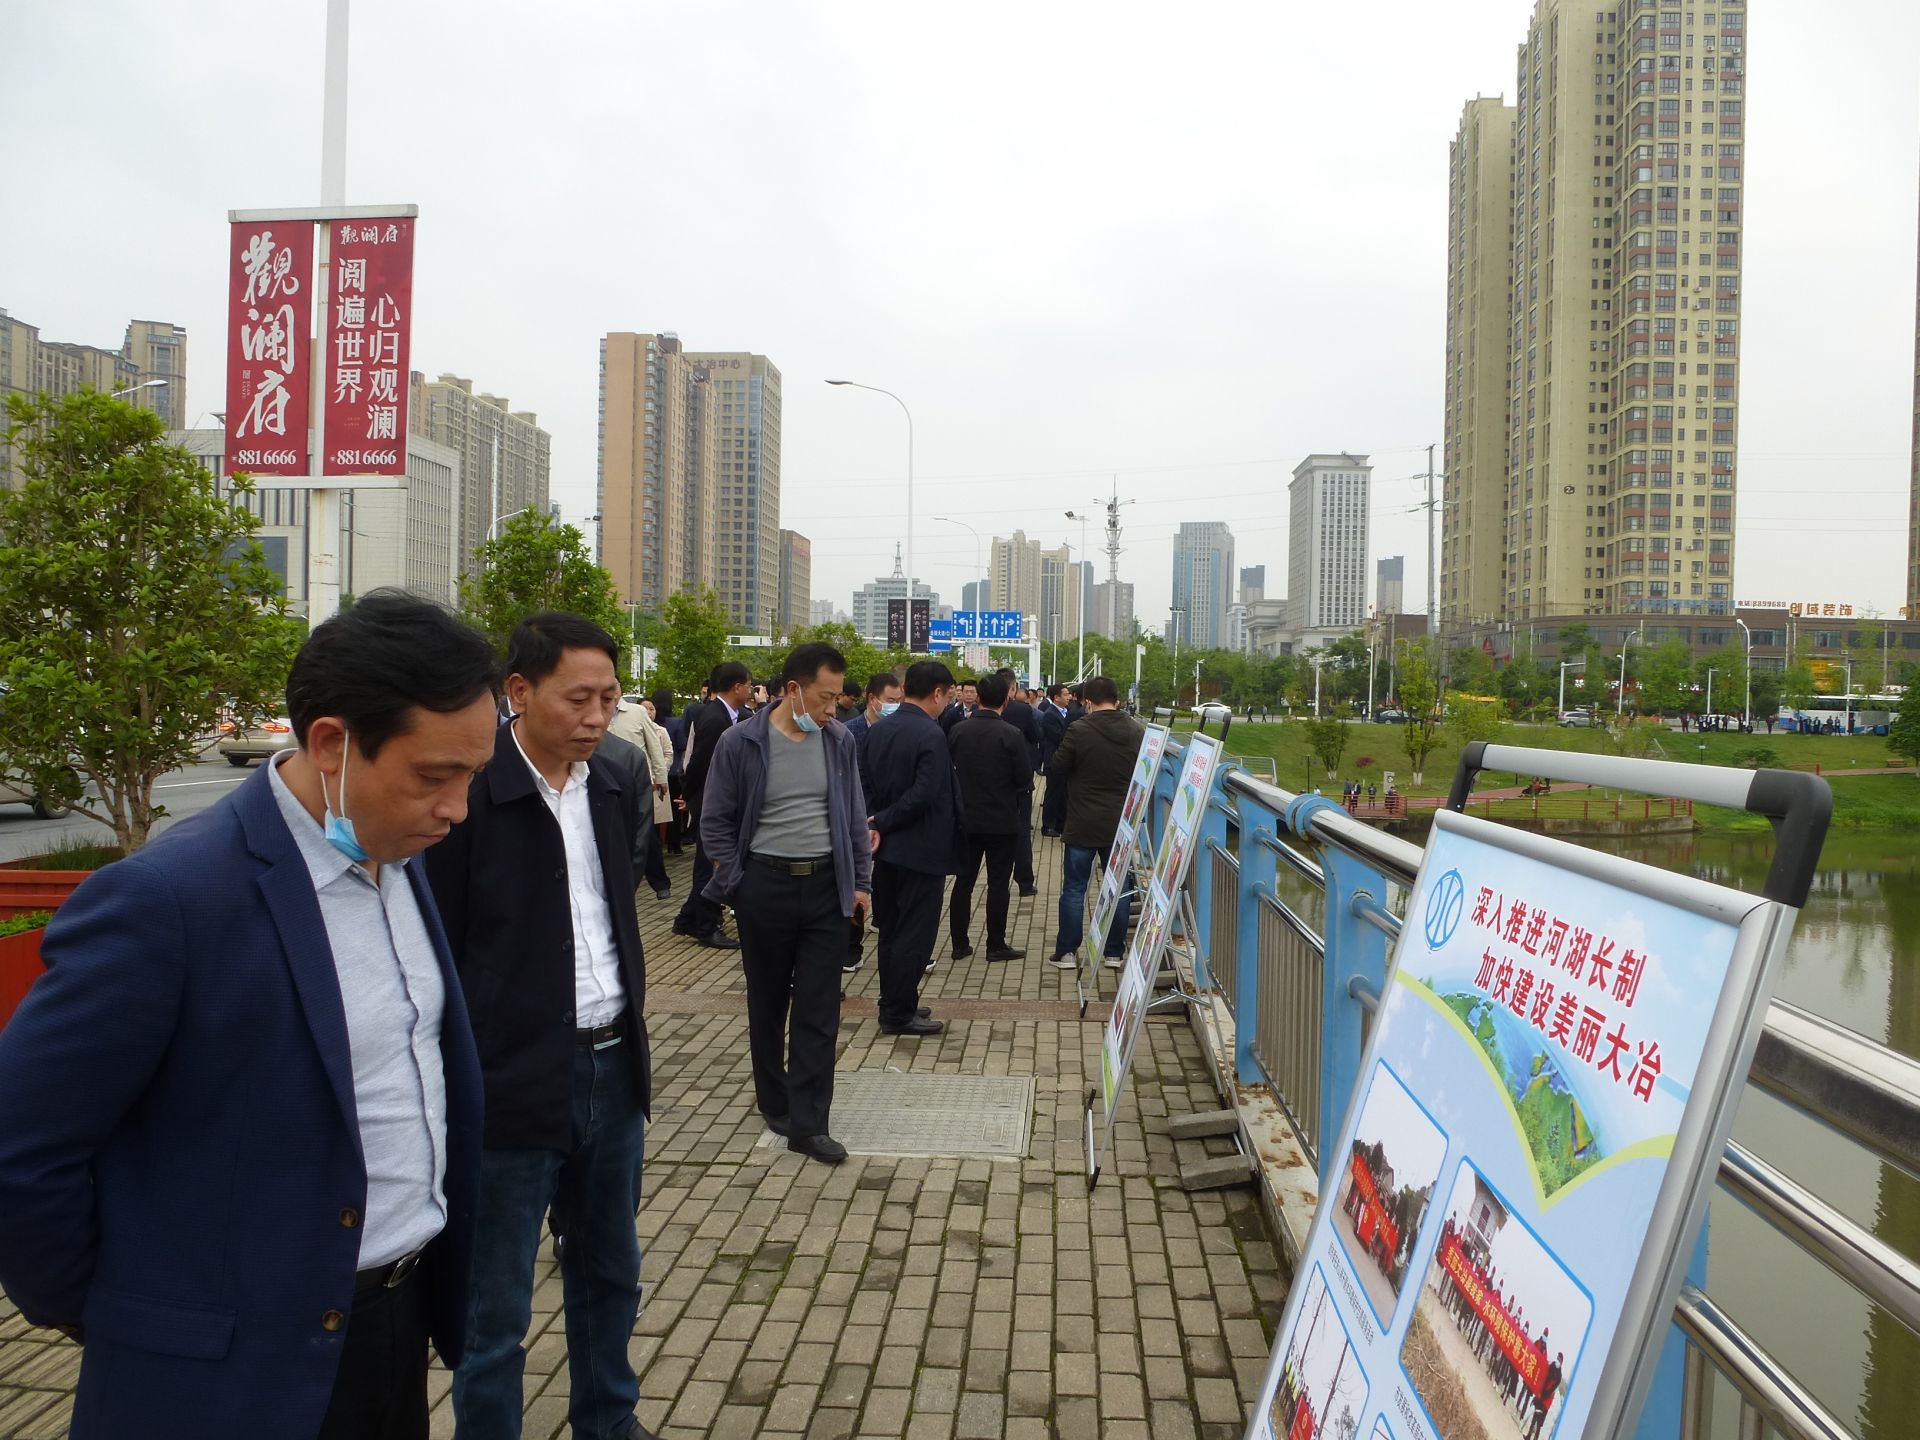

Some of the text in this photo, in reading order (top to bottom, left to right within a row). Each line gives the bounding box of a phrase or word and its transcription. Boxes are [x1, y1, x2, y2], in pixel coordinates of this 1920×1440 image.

[334, 257, 367, 404] 阅遍世界
[366, 292, 401, 440] 心归观澜
[238, 449, 297, 466] 8816666
[336, 449, 397, 466] 8816666
[1470, 885, 1648, 1008] 深入推进河湖长制
[1473, 946, 1664, 1104] 加快建设美丽大冶
